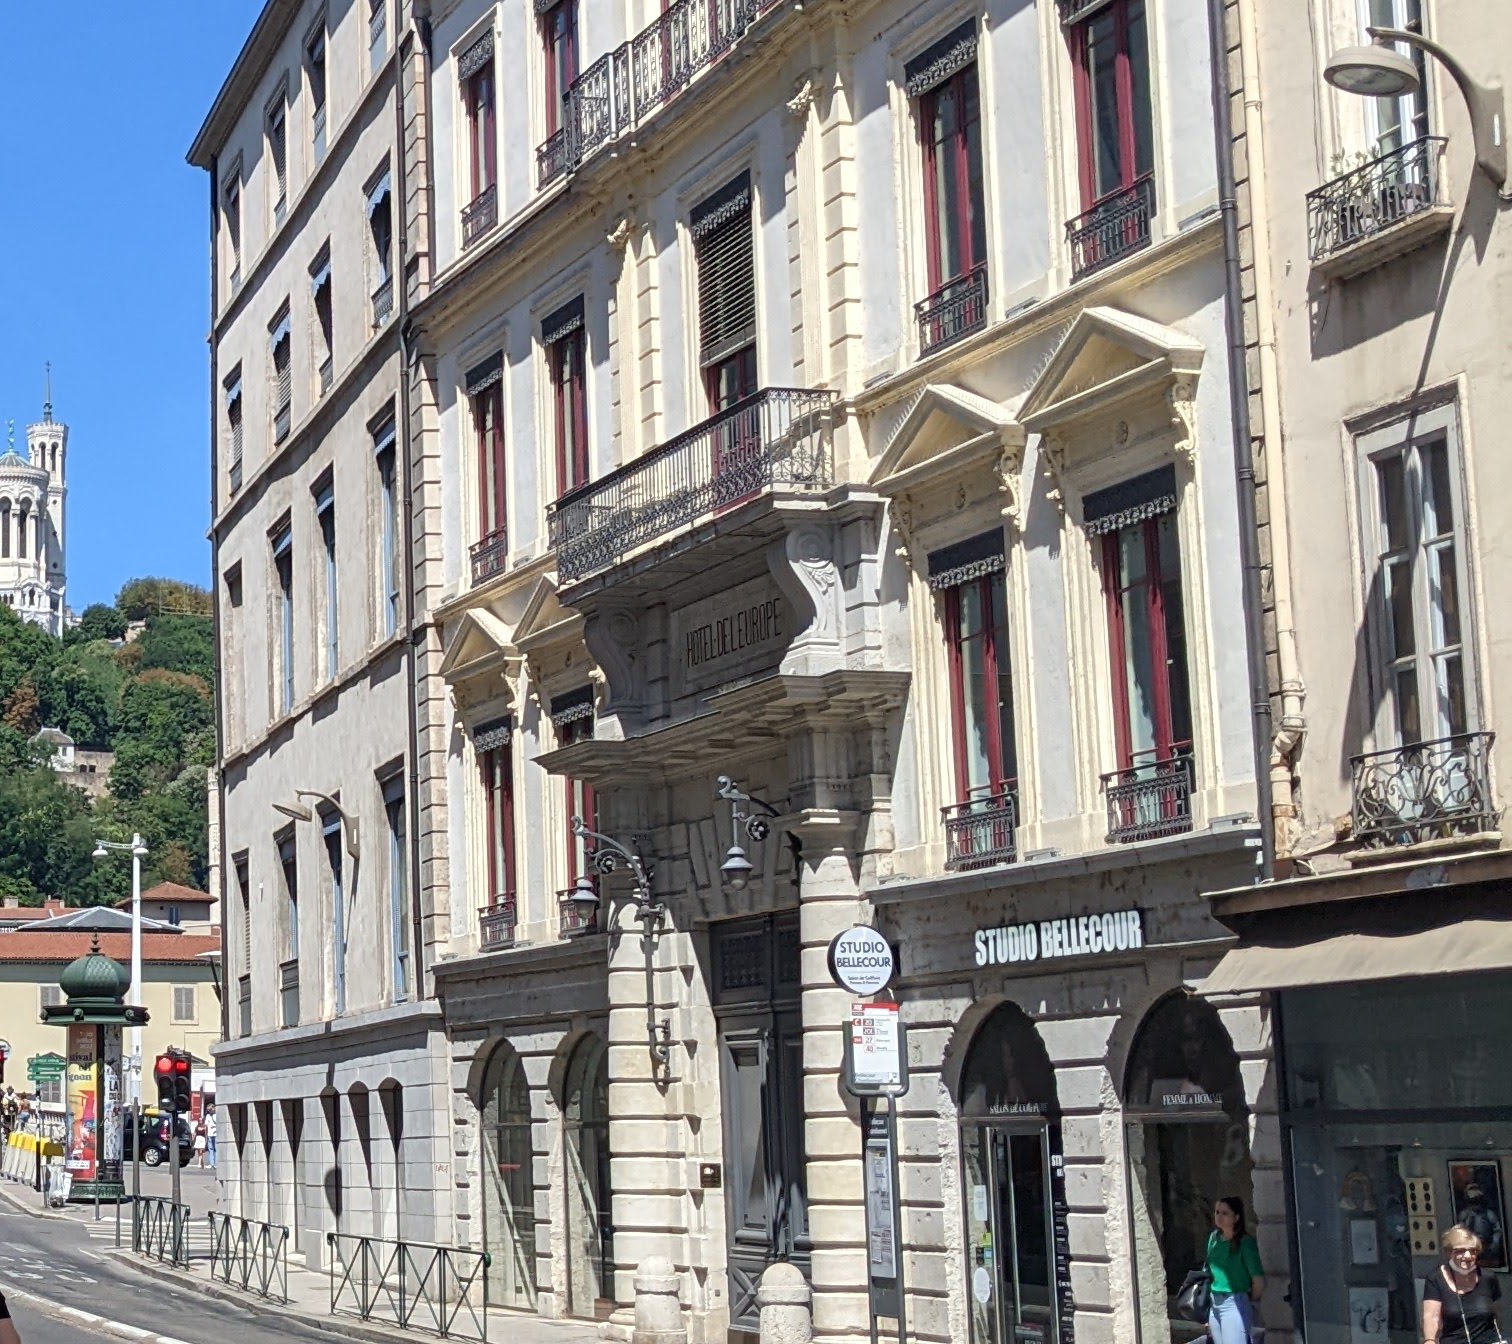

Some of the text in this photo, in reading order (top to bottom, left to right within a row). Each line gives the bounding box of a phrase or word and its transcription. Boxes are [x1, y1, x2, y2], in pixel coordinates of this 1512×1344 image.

[975, 910, 1142, 966] STUDIO BELLECOUR
[840, 941, 885, 954] STUDIO
[837, 957, 891, 968] BELLECOUR
